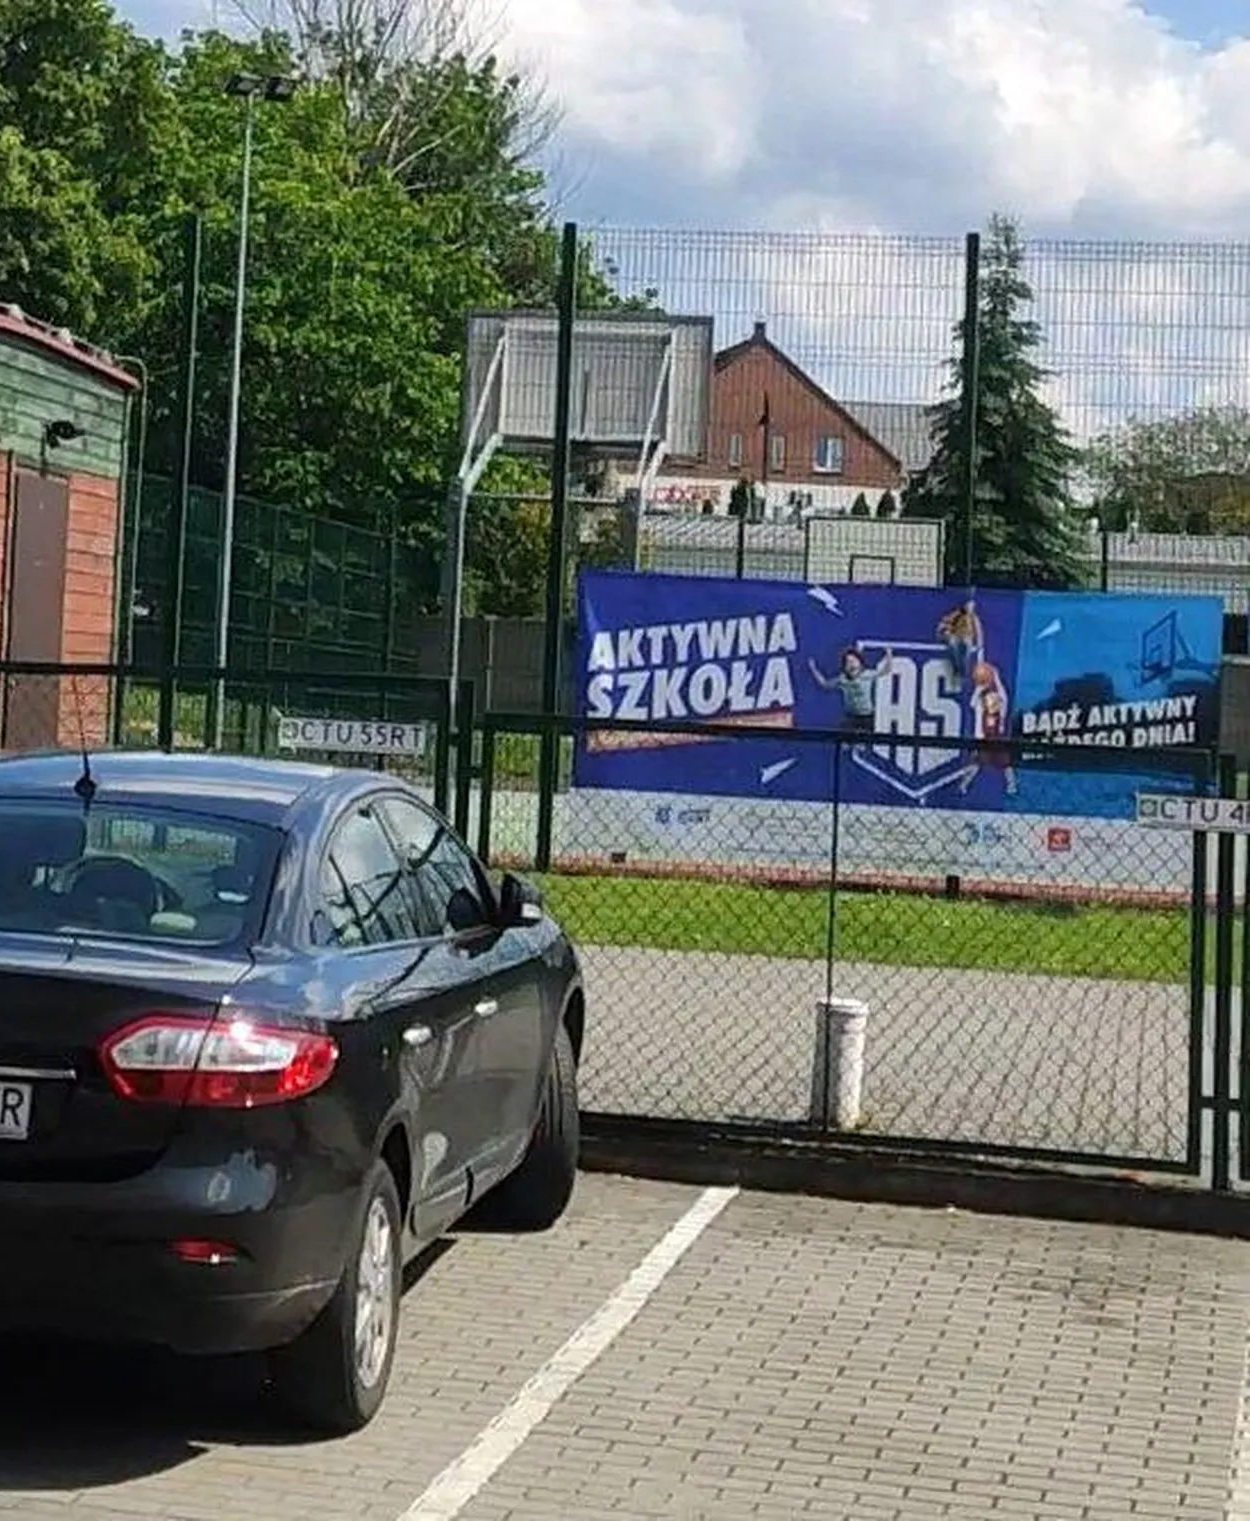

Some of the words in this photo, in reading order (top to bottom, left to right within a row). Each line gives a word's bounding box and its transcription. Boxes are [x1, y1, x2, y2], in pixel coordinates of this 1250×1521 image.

[587, 612, 797, 673] AKTYWNA
[586, 656, 795, 721] SZKOŁA
[301, 721, 353, 745] CTU
[872, 656, 962, 775] AS
[1022, 702, 1083, 737] BĄDŹ
[1086, 695, 1197, 727] AKTYWNY
[1132, 720, 1196, 748] DNIA!
[1161, 799, 1220, 822] CTU
[1229, 802, 1250, 825] 4
